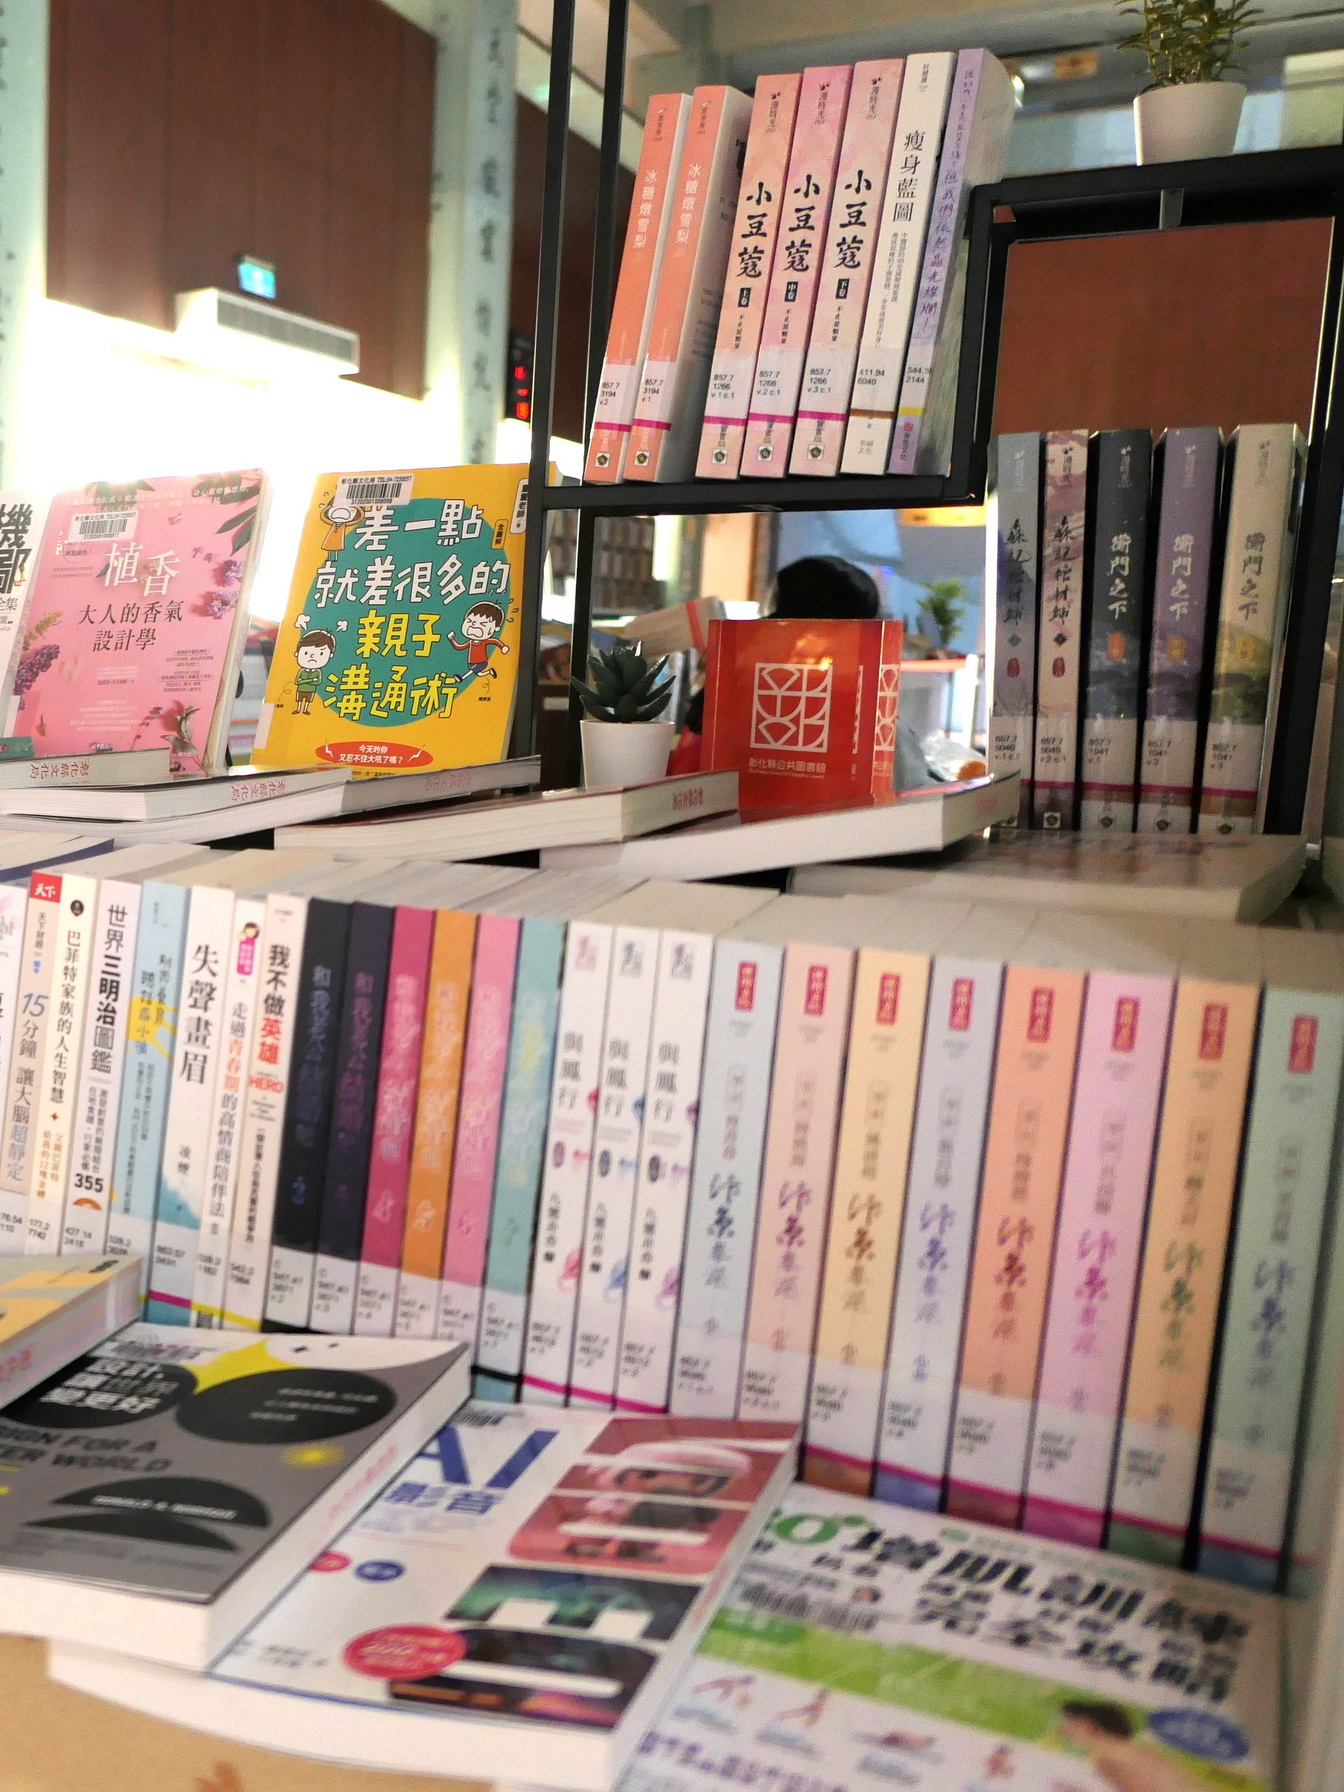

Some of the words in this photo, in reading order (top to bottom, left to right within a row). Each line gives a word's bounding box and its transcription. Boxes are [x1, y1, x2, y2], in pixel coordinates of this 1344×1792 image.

[676, 164, 701, 243] 冰糖燉雪梨
[893, 132, 925, 222] 瘦身藍圖
[634, 169, 657, 249] 冰糖燉雪梨
[736, 182, 772, 279] 小豆蔻
[784, 174, 820, 272] 小豆蔻
[835, 170, 872, 269] 小豆蔻
[760, 379, 776, 387] 1266
[354, 499, 484, 550] 差一點
[103, 542, 182, 597] 植香
[315, 554, 511, 606] 就差很多的
[1108, 532, 1132, 620] 衙門之下
[79, 600, 184, 627] 大人的香氣
[92, 628, 157, 652] 設計學
[356, 609, 442, 658] 親子
[323, 664, 459, 721] 溝通術
[338, 753, 403, 764] 又忍不住大吼了嗎？
[359, 745, 388, 753] 今天的你
[749, 758, 826, 773] 彰化縣公共圖書館
[35, 883, 56, 897] 天下
[50, 930, 81, 1105] 巴菲特家族的人生智慧
[90, 904, 128, 1074] 世界三明治圖鑑
[180, 944, 219, 1086] 失聲畫眉
[257, 944, 291, 1066] 我不做英雄
[20, 991, 49, 1060] 15分鐘
[74, 1173, 104, 1193] 355
